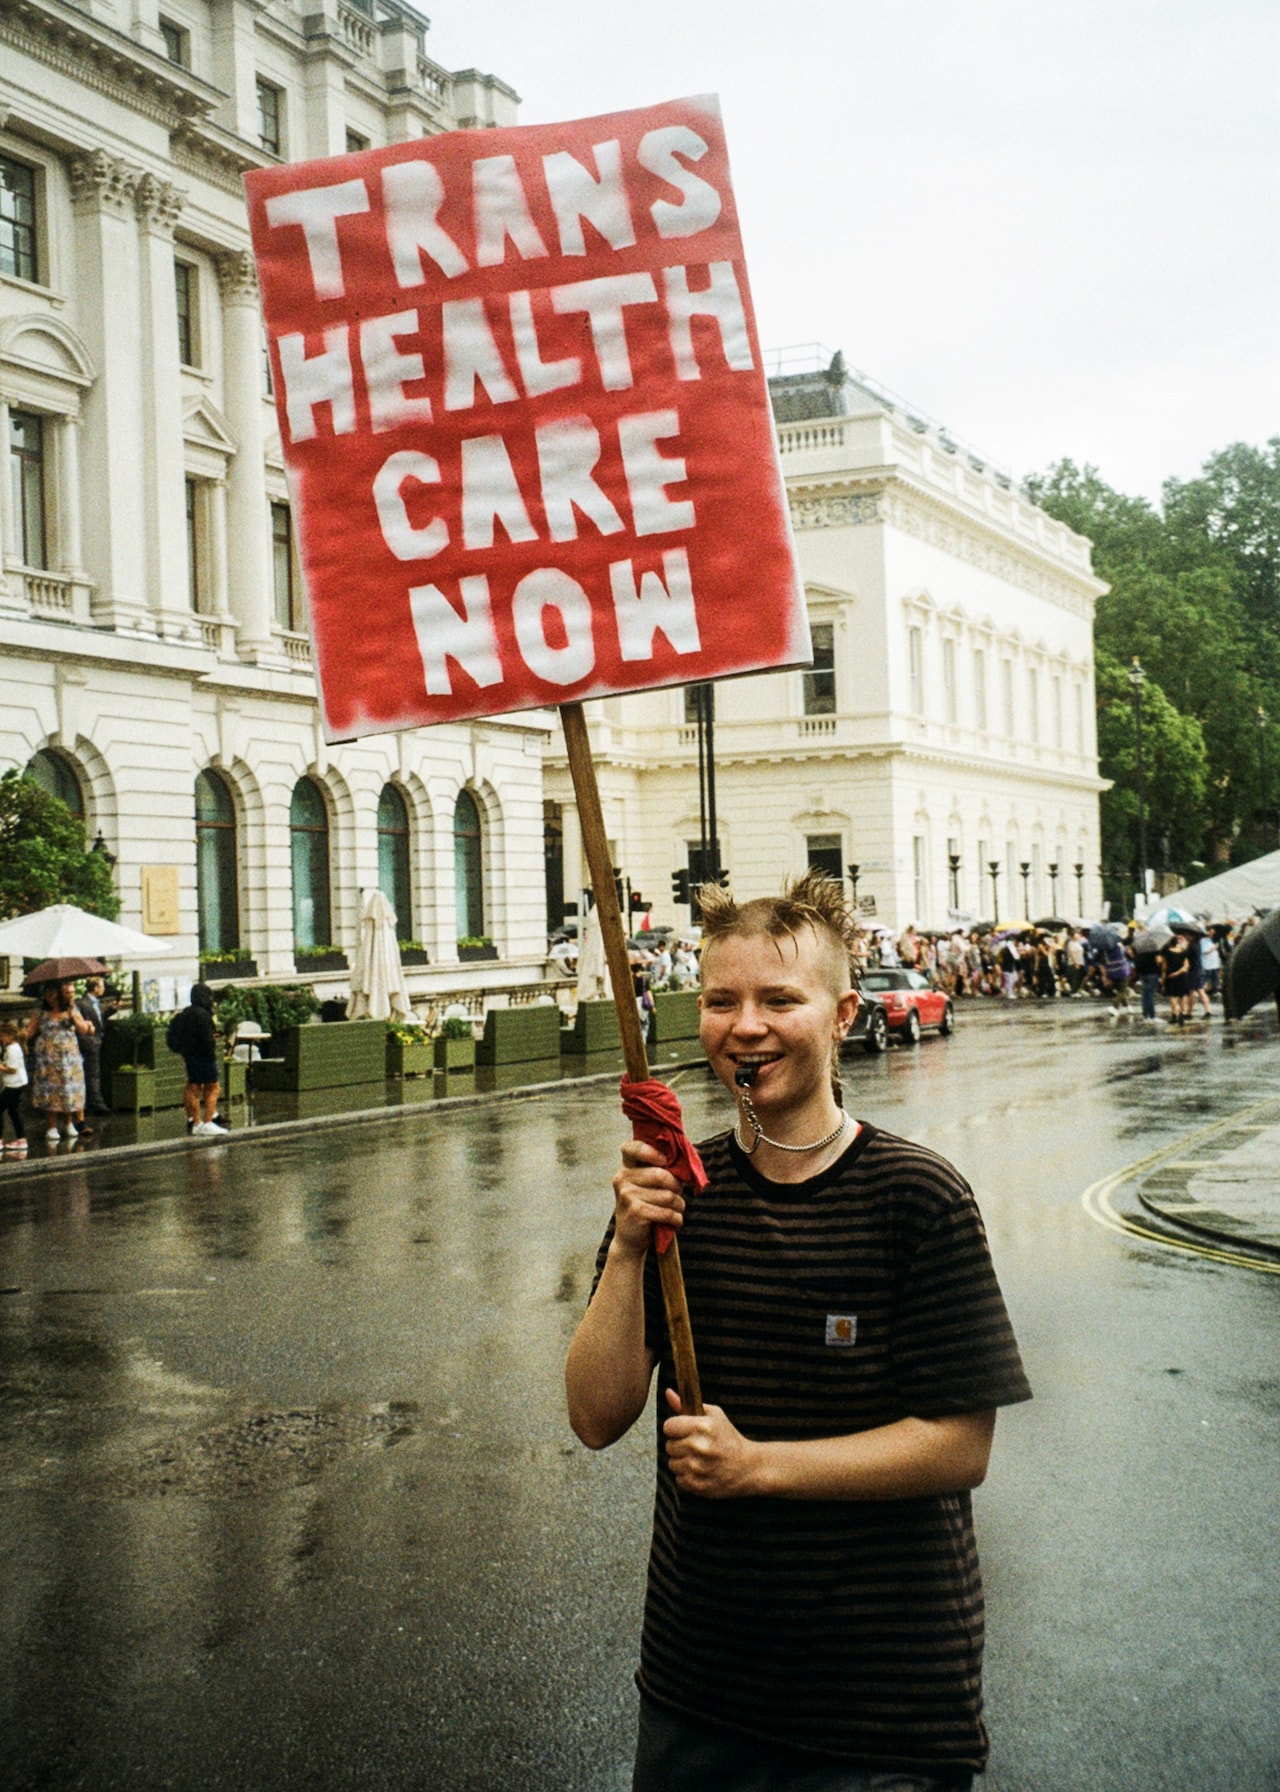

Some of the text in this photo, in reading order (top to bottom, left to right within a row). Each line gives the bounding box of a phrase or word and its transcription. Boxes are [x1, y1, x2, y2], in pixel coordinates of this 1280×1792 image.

[265, 126, 721, 299] TRANS
[278, 261, 755, 443] HEALTH
[372, 409, 695, 560] CARE
[408, 548, 701, 695] NOW
